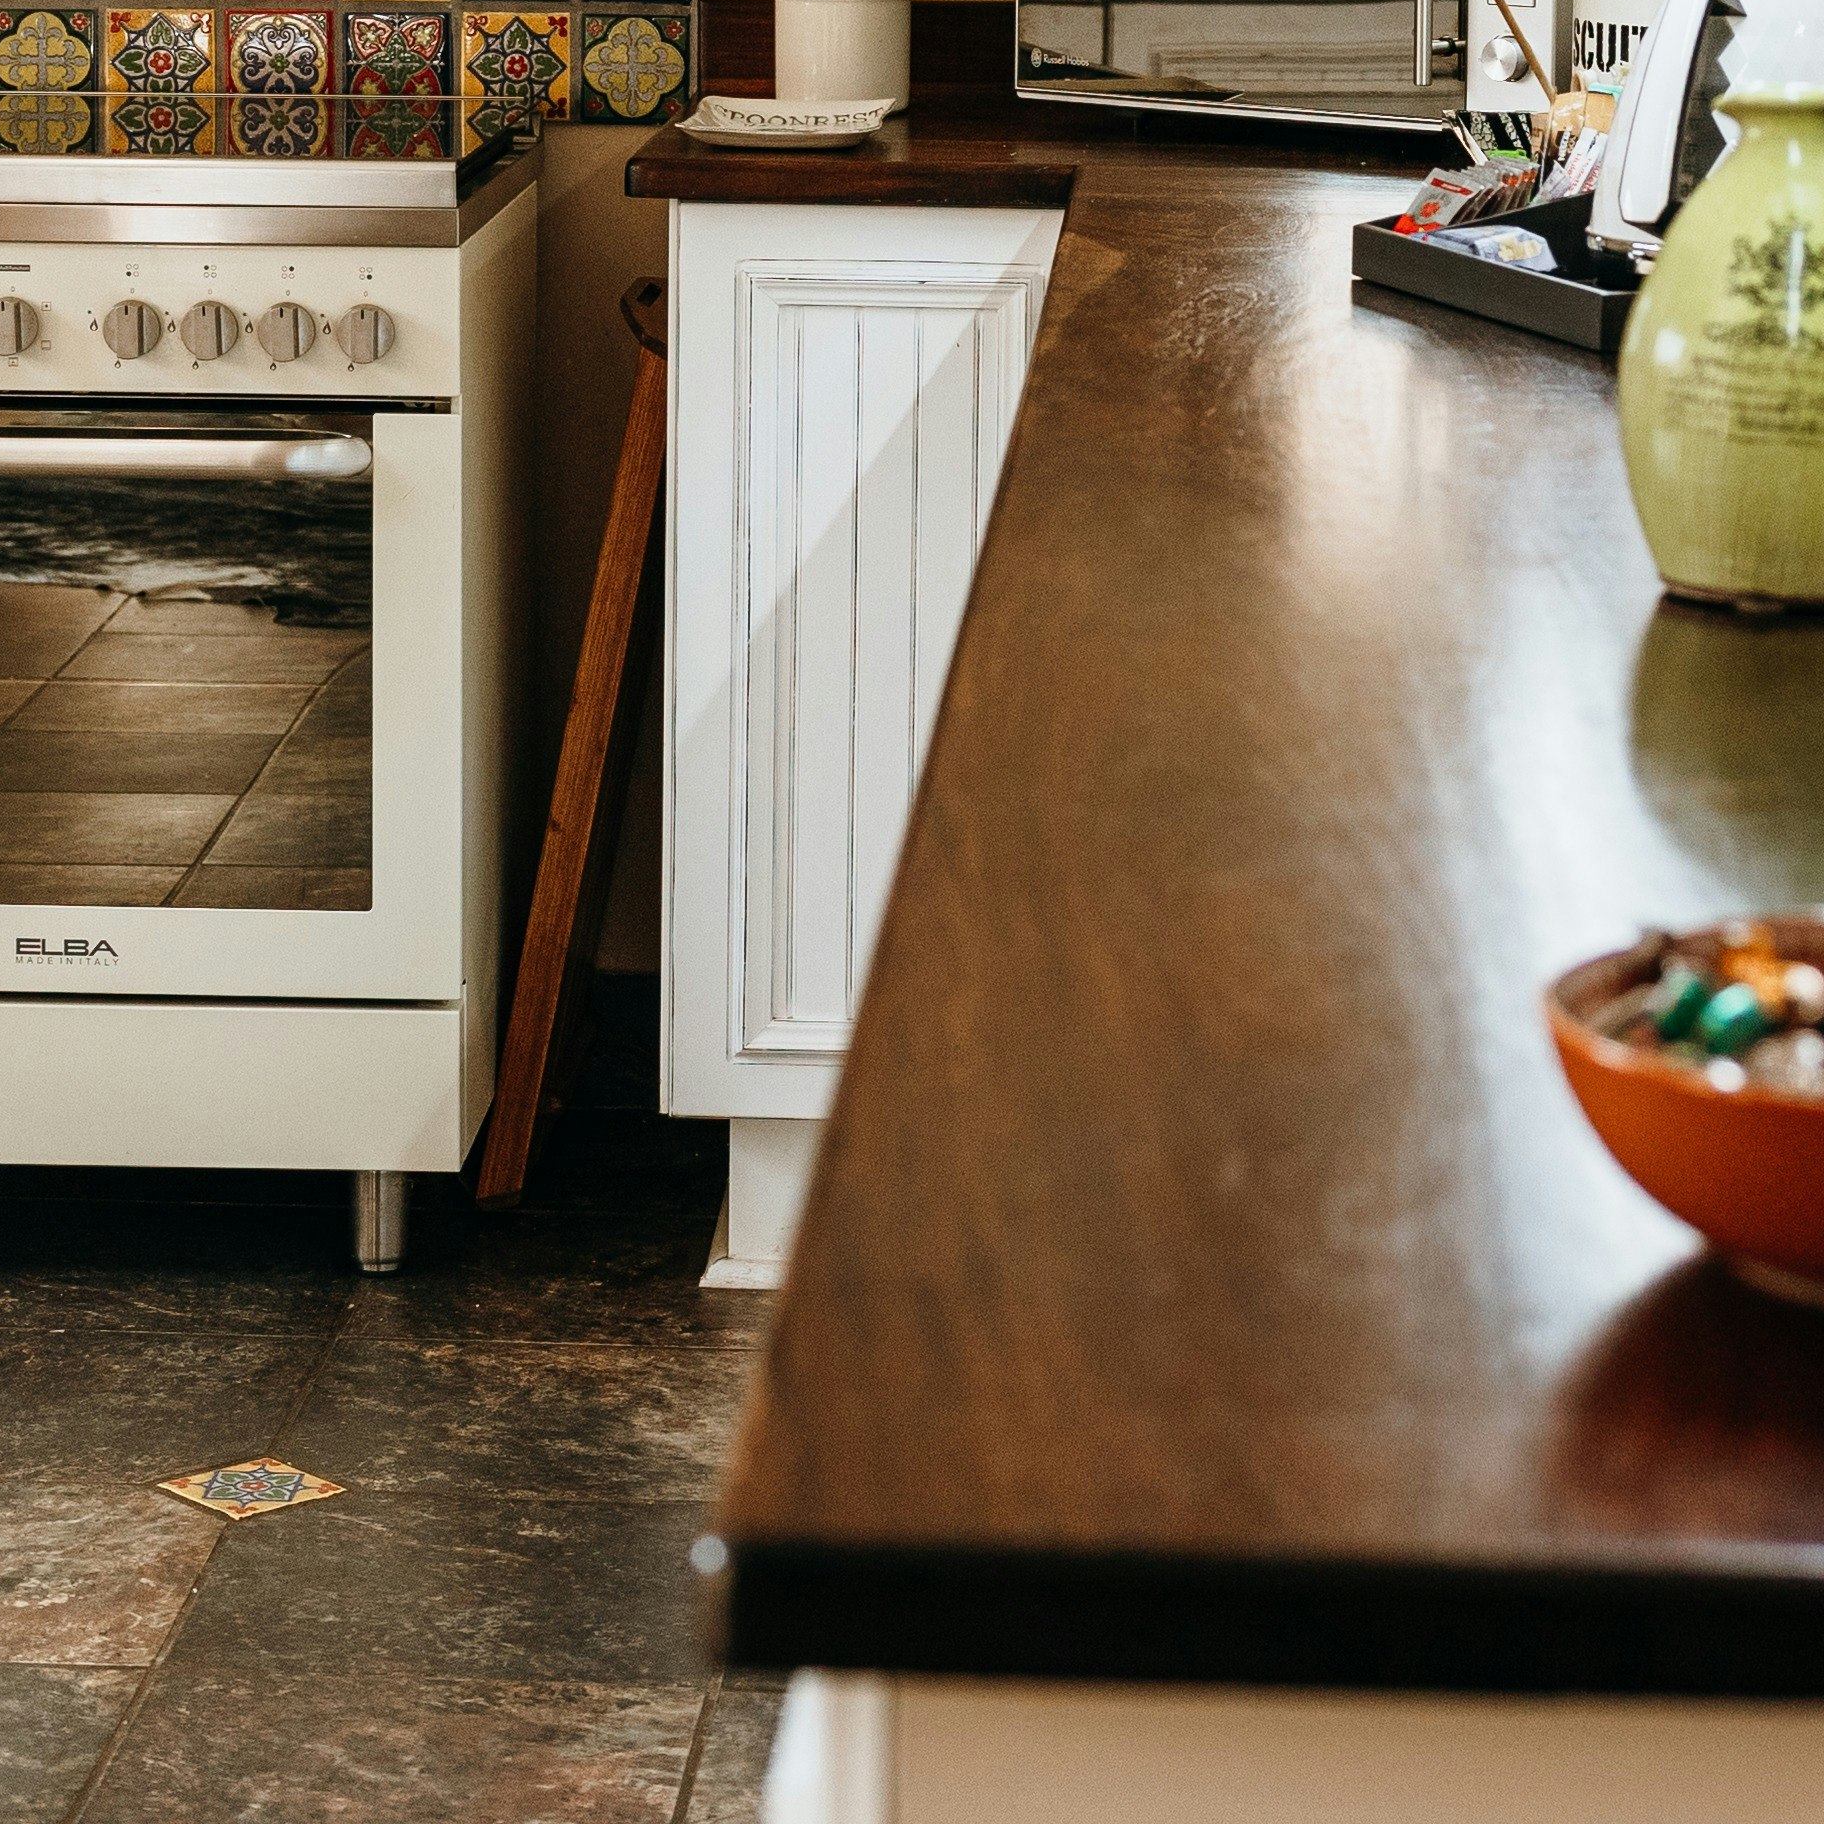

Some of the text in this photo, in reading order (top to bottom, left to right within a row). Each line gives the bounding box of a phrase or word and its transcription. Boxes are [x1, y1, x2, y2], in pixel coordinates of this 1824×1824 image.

[1066, 55, 1090, 67] Hobbs
[16, 937, 119, 957] ELBA
[15, 956, 119, 967] MADE IN ITALY
